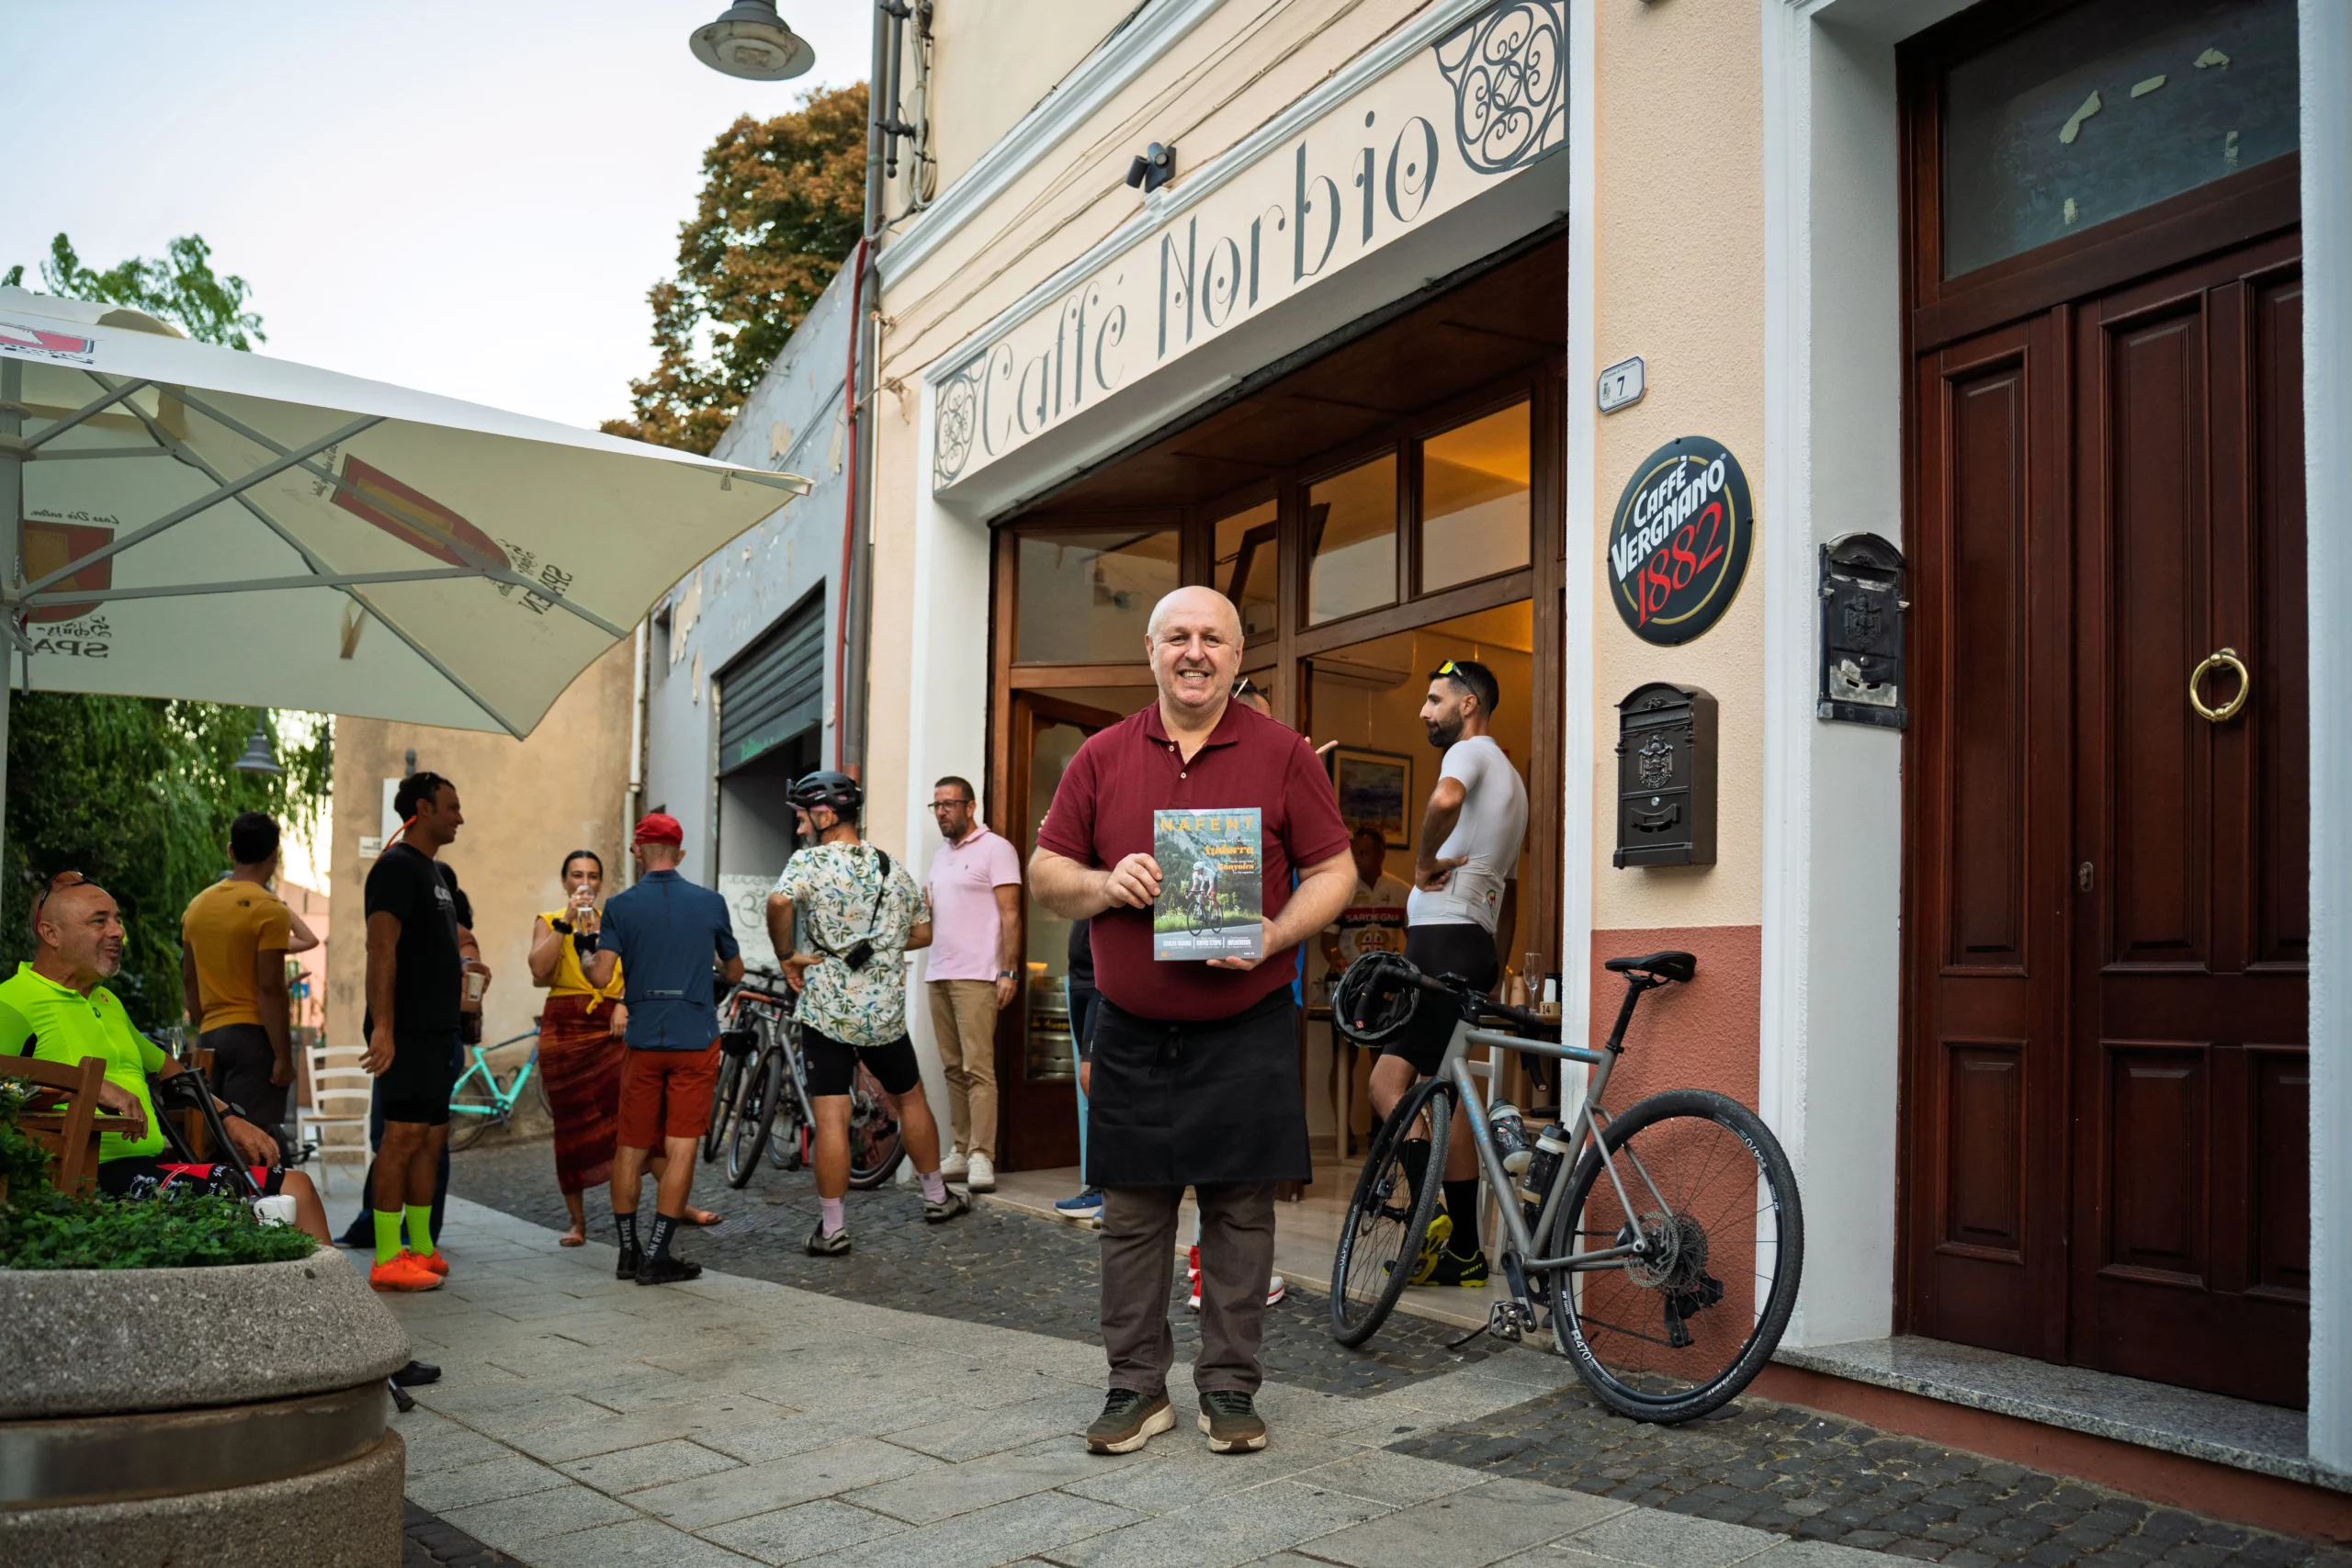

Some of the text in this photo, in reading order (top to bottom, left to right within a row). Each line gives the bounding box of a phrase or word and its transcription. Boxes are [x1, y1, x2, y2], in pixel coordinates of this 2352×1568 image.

[1158, 110, 1439, 362] Norbio
[1616, 375, 1625, 397] 7
[1611, 458, 1725, 582] VERGNANO
[1636, 502, 1724, 628] 1882
[1160, 817, 1254, 832] NAFENT
[1204, 843, 1254, 855] Andorra
[1345, 913, 1400, 922] SARDEGNA
[1542, 1004, 1551, 1015] 14
[651, 1220, 667, 1244] RYSEL
[1460, 1262, 1483, 1277] SCOTT
[1571, 1328, 1592, 1360] R470
